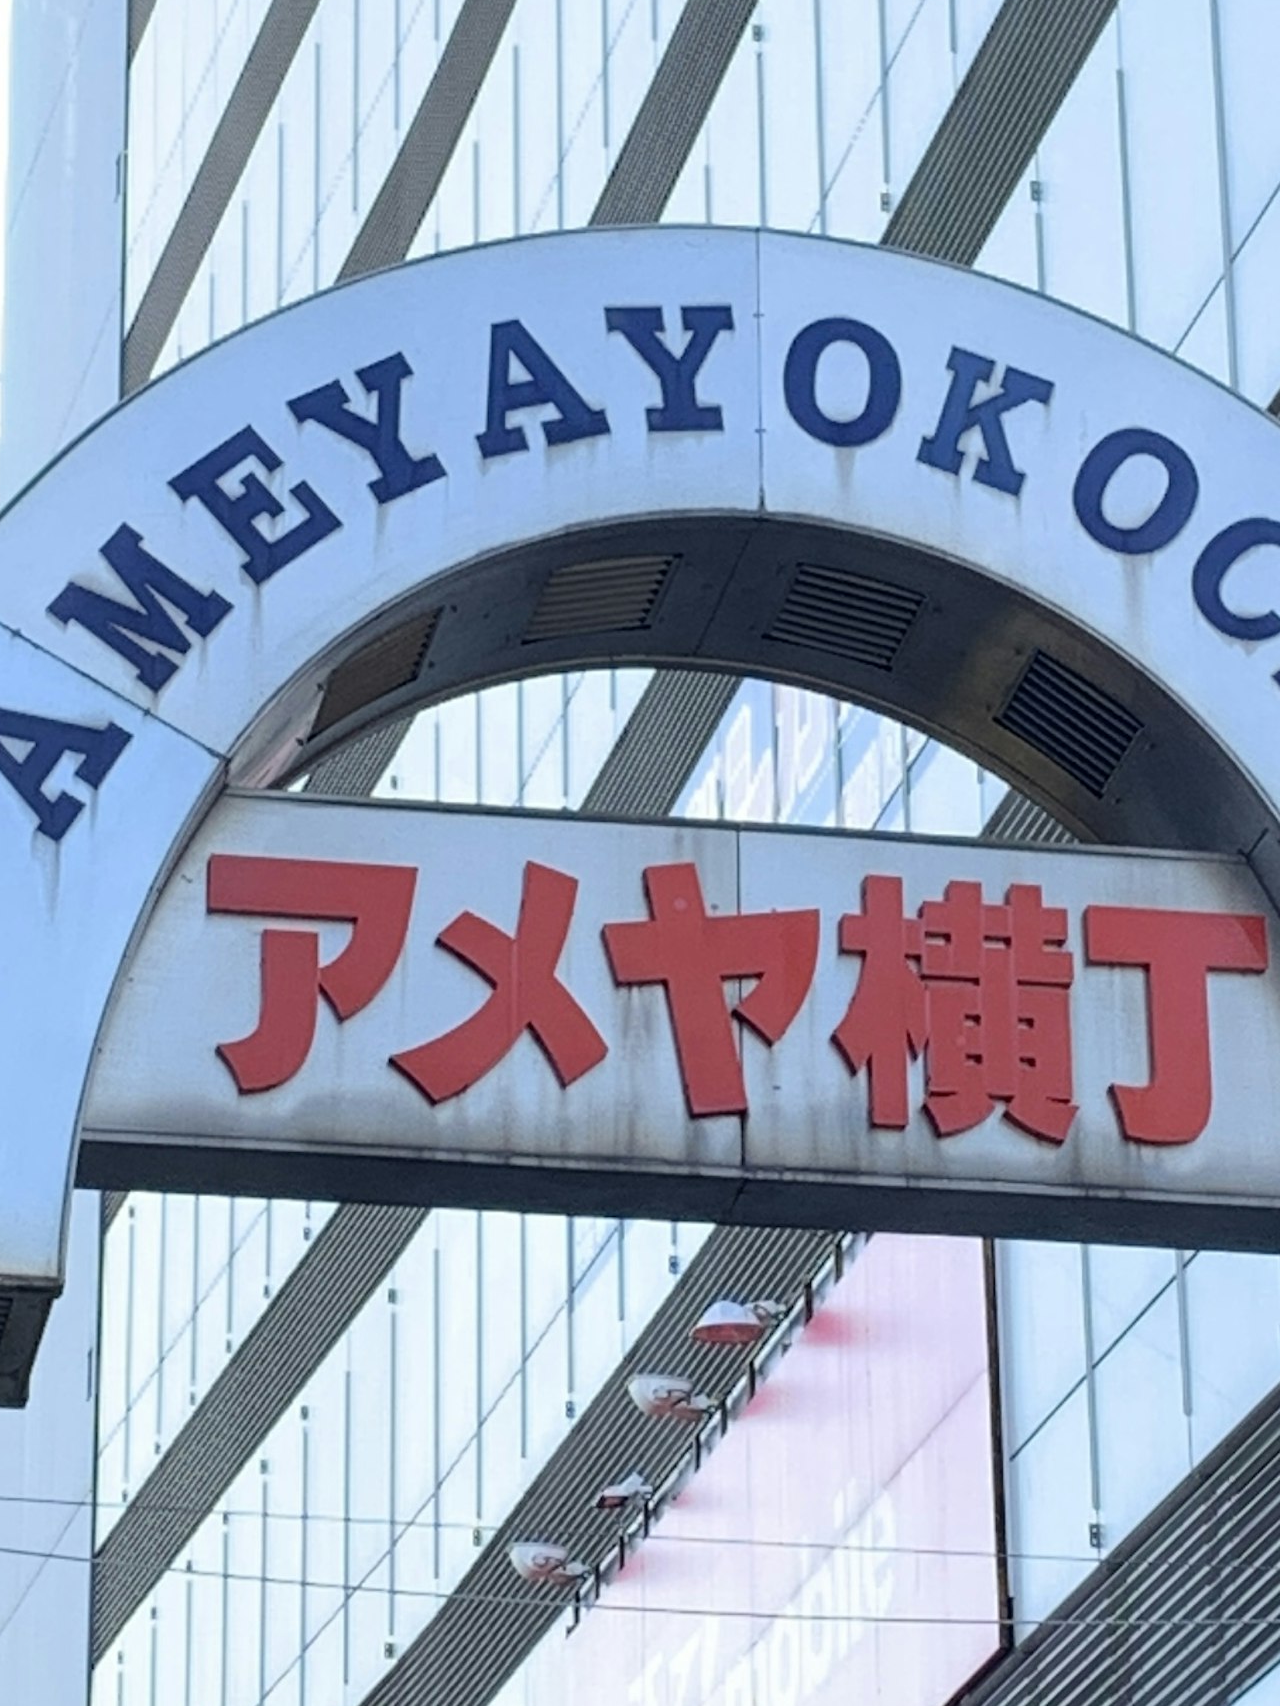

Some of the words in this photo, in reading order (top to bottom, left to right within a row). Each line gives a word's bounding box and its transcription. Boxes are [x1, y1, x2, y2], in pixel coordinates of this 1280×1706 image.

[206, 852, 1269, 1148] アメヤ横丁
